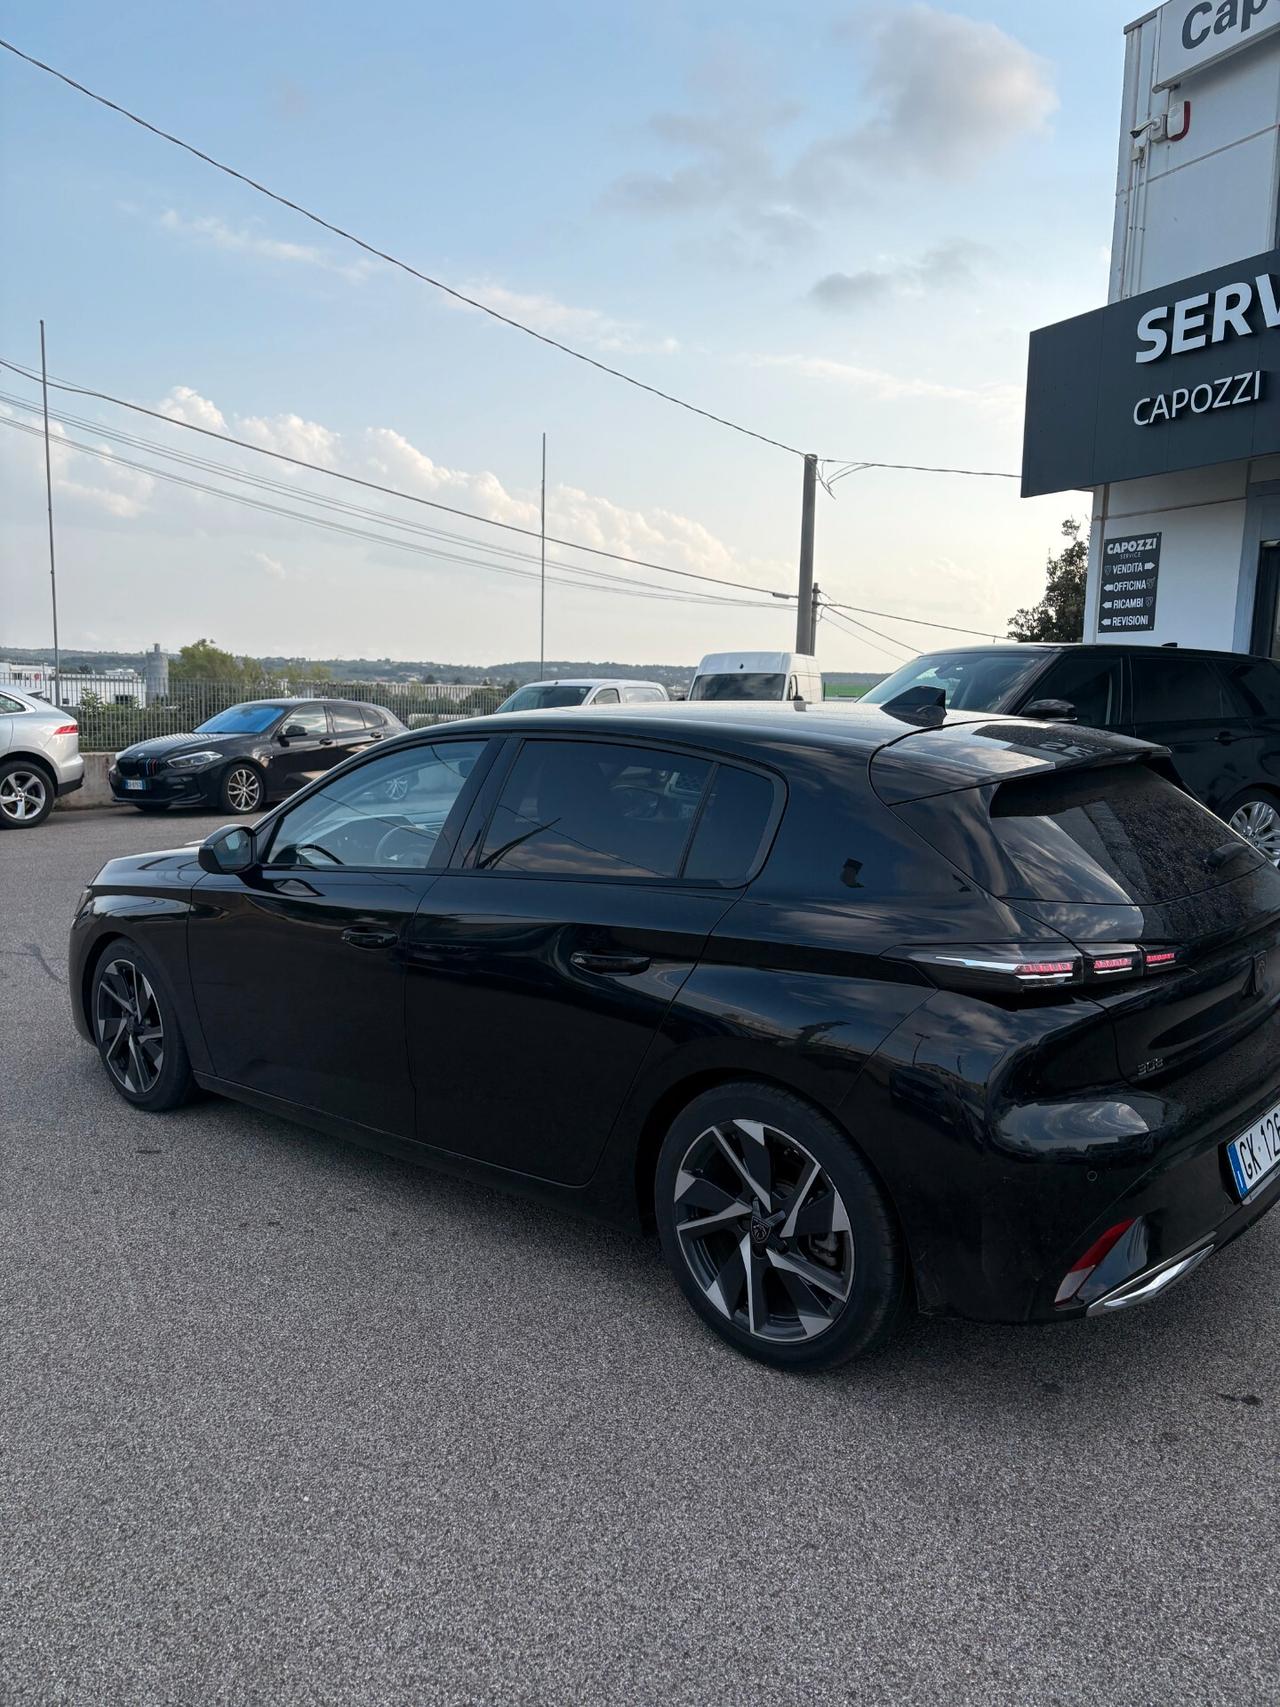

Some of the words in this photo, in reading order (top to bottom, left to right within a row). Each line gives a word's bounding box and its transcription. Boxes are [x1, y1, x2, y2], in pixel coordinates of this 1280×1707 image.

[1182, 0, 1268, 50] Cap
[1133, 370, 1261, 426] CAPOZZI
[1107, 538, 1157, 554] CAPOZZI
[1120, 551, 1142, 560] SERVICE
[1113, 562, 1143, 575] VENDITA
[1113, 580, 1147, 592] OFFICINA
[1113, 598, 1144, 609] RICAMBI
[1112, 615, 1149, 627] REVISIONI
